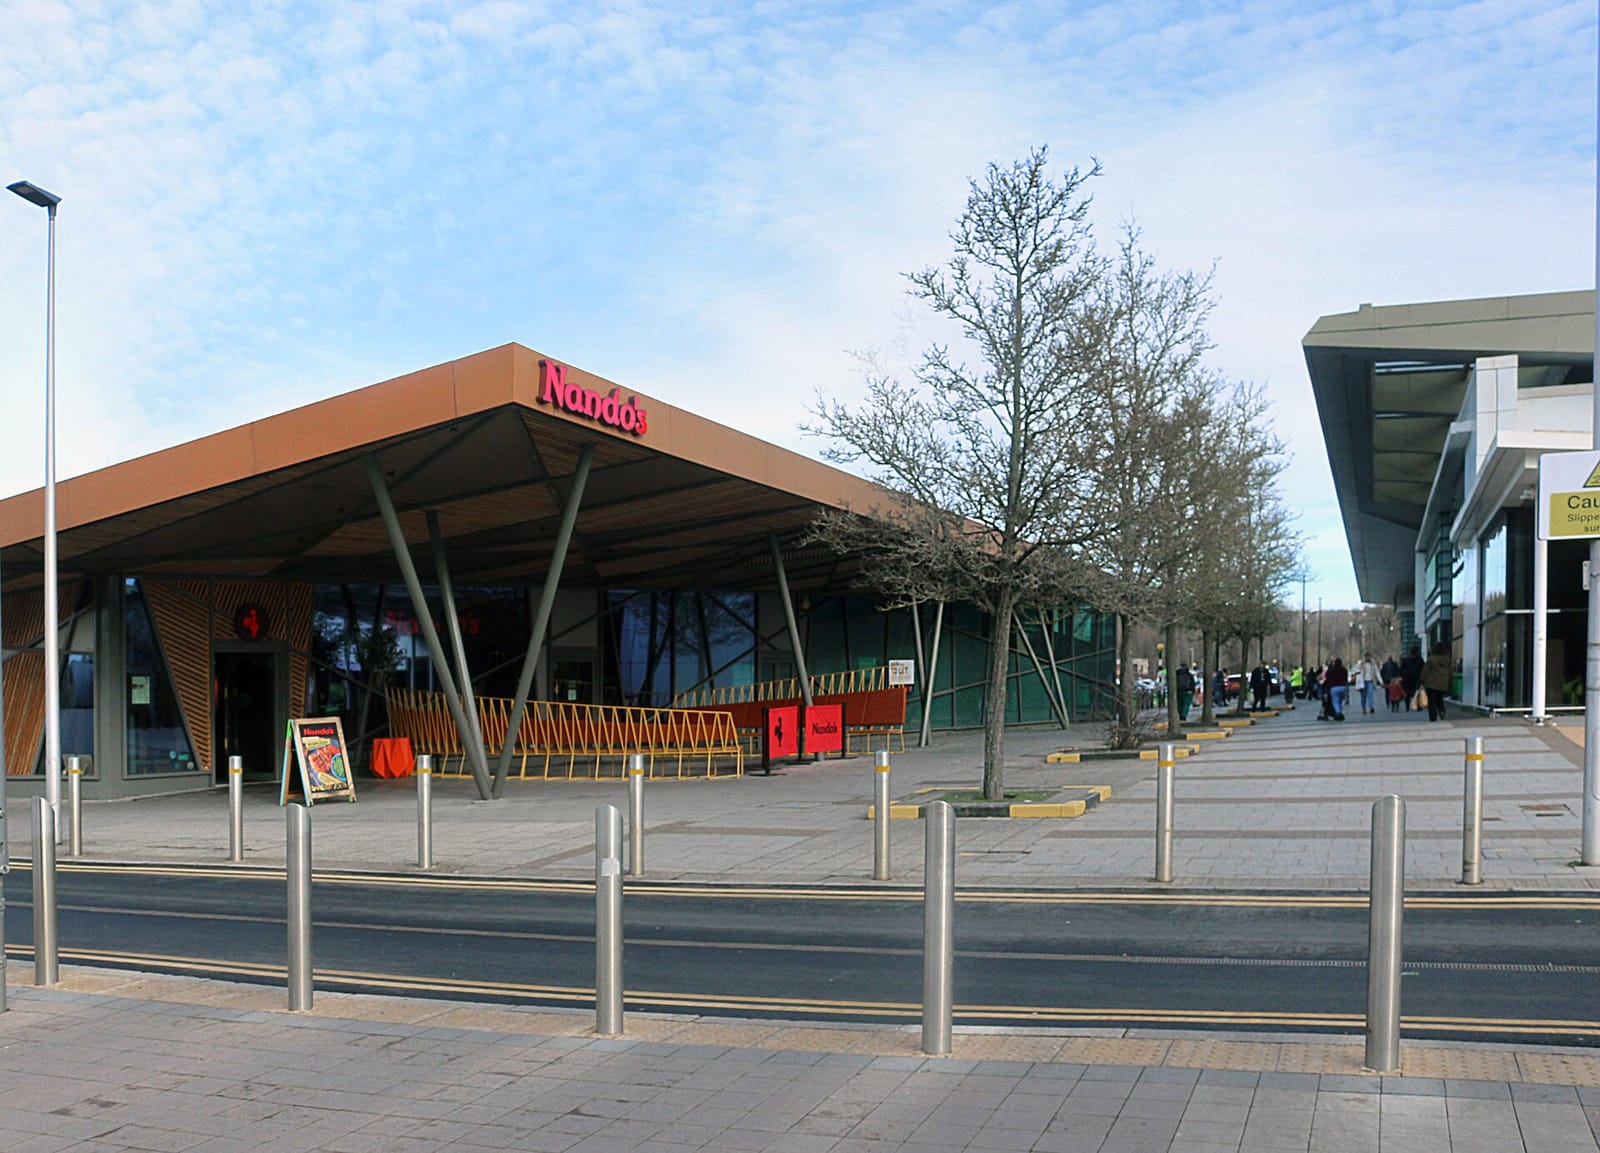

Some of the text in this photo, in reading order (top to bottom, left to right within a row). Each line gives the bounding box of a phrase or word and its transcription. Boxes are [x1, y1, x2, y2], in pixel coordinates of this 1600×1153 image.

[537, 359, 648, 436] Nando's
[303, 727, 335, 736] Nando's
[811, 722, 838, 736] Nando's
